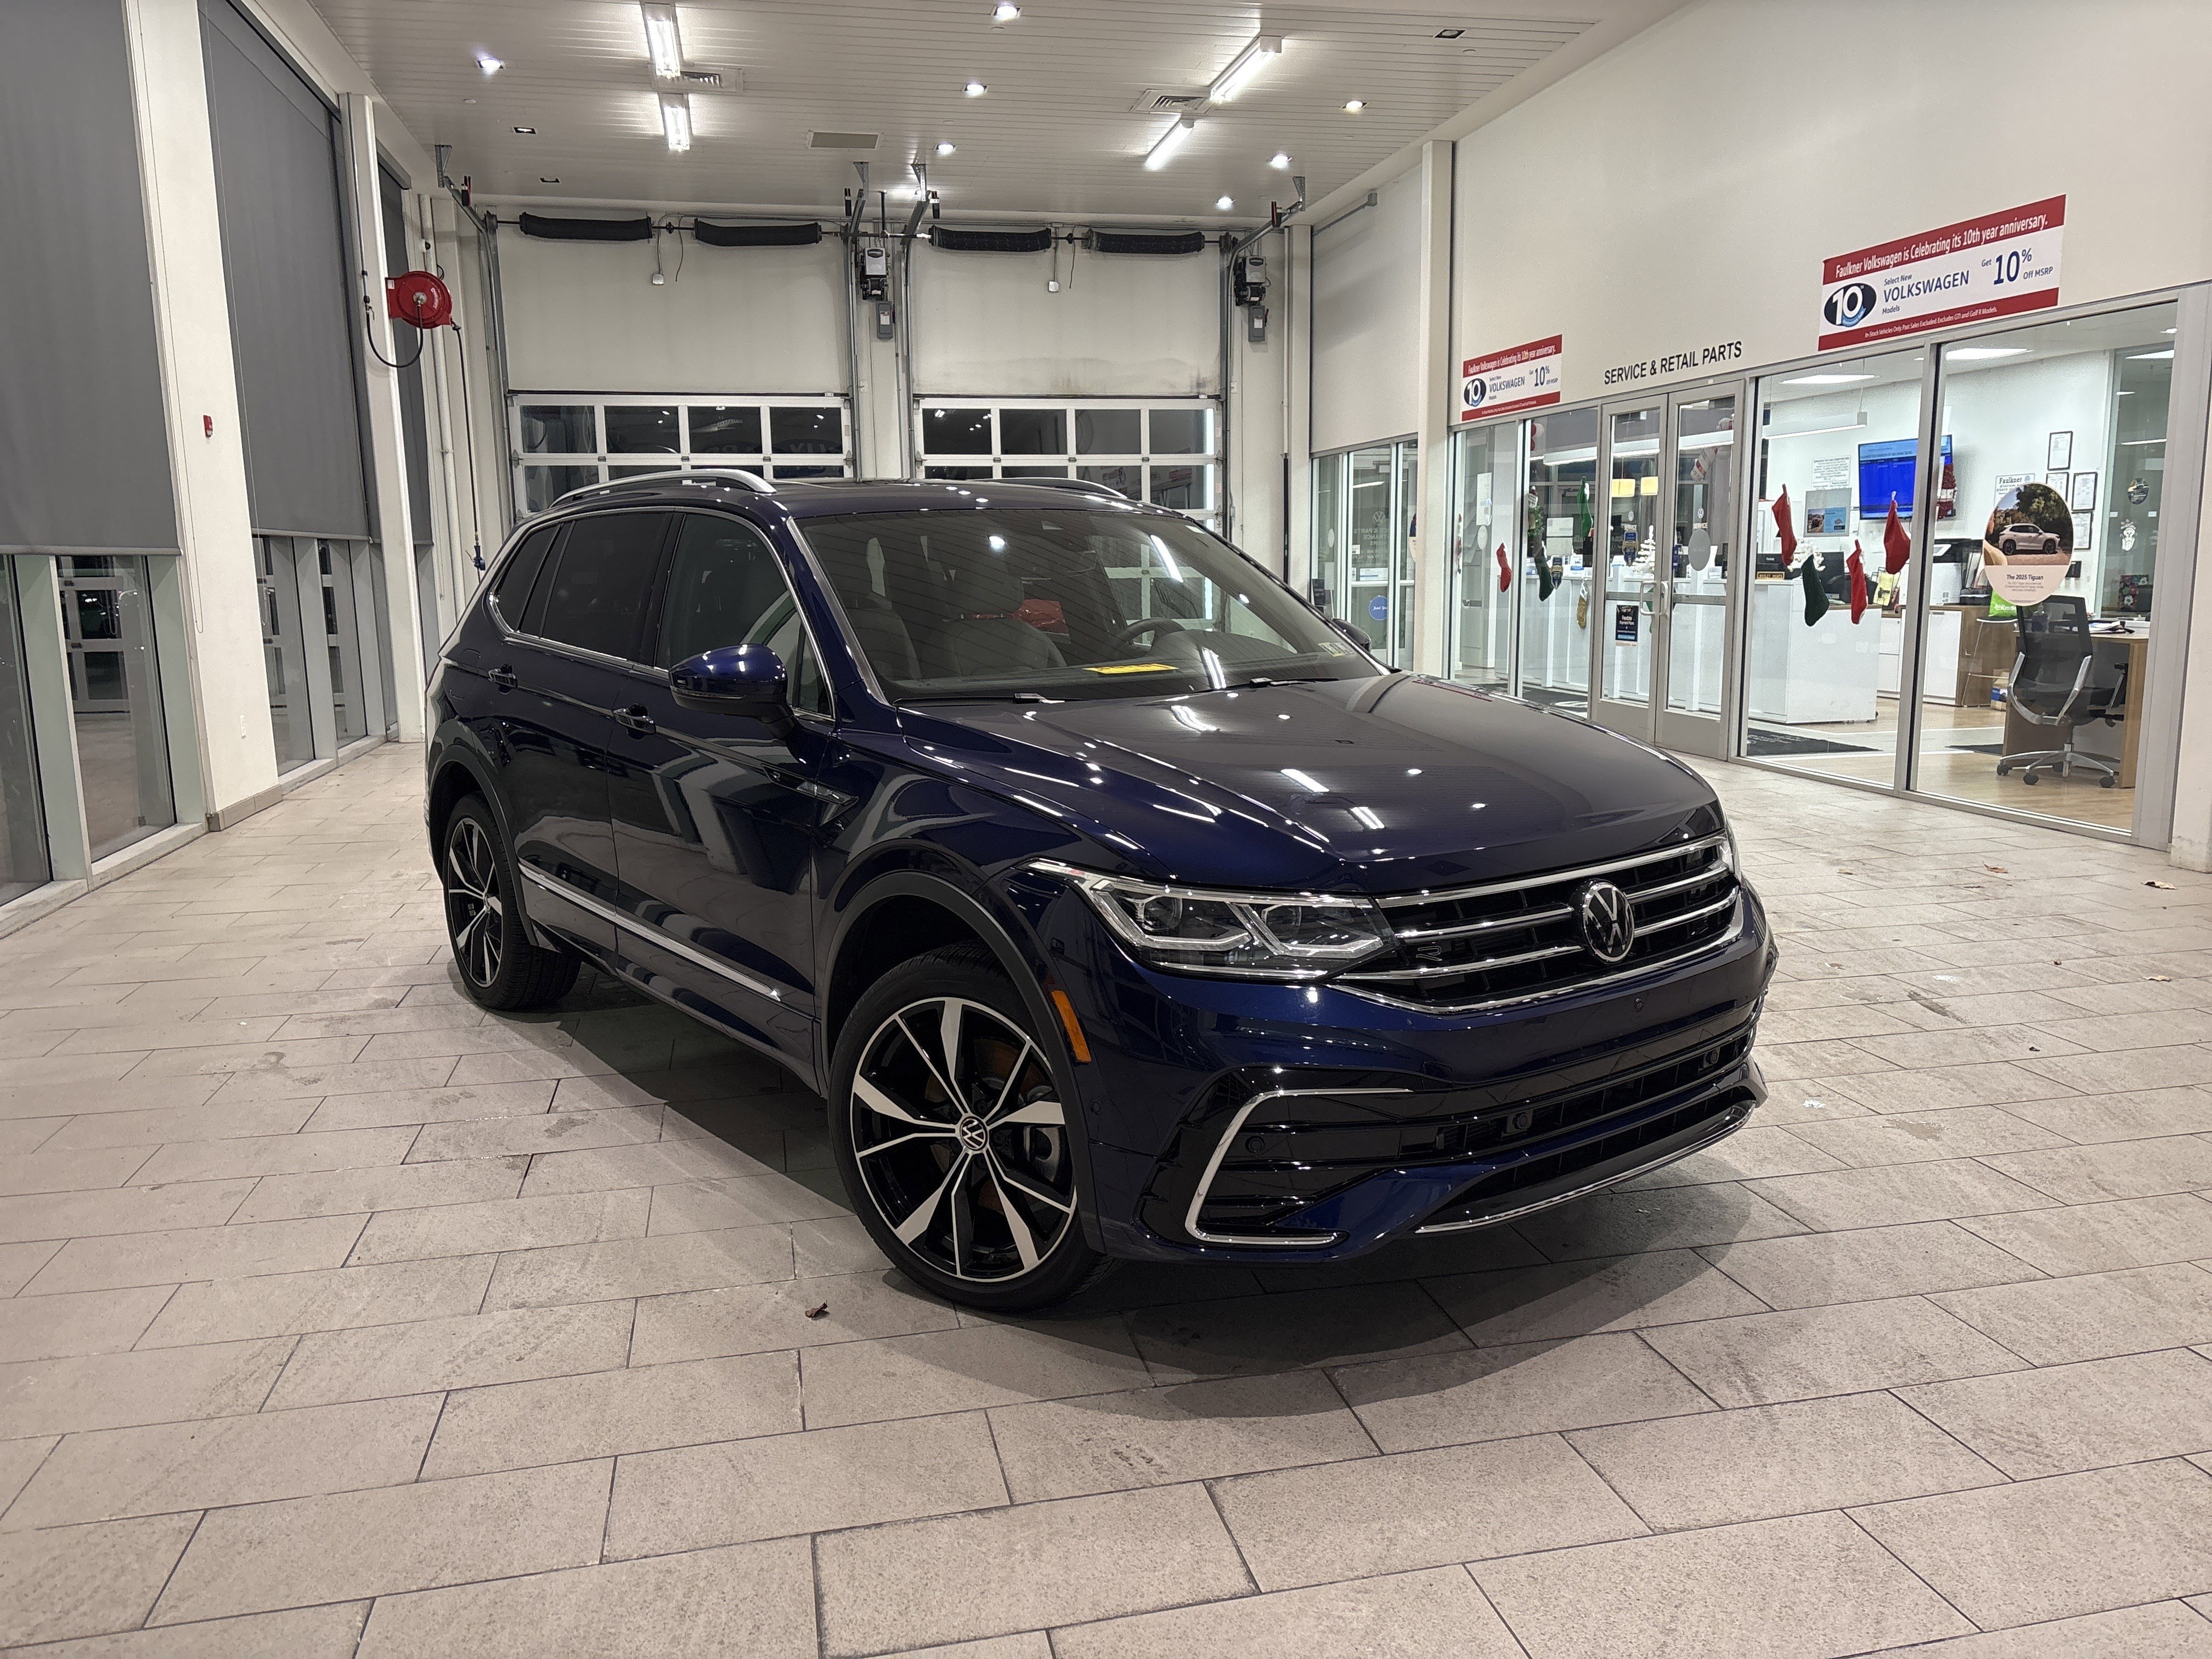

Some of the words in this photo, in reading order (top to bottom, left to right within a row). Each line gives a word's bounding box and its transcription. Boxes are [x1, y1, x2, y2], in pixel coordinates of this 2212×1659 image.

[1836, 261, 1863, 279] Faulkner
[1864, 251, 1902, 272] Volkswagen
[1903, 247, 1909, 261] is
[1911, 237, 1950, 259] Celebrating
[1963, 227, 1980, 246] 10th
[1981, 225, 1999, 245] year
[1999, 213, 2048, 236] anniversary.
[1982, 259, 1992, 267] Get
[1884, 276, 1900, 286] Select
[1901, 274, 1912, 284] New
[2023, 270, 2034, 280] Off
[2035, 266, 2053, 278] MSRP
[1883, 270, 1970, 303] VOLKSWAGEN
[1832, 285, 1863, 325] 10
[1882, 304, 1900, 315] Models
[1604, 360, 1646, 386] SERVICE
[1650, 359, 1657, 375] &
[1660, 350, 1699, 375] RETAIL
[1702, 340, 1742, 366] PARTS
[1489, 376, 1525, 393] VOLKSWAGEN
[1999, 476, 2023, 484] Faulkner
[2028, 574, 2044, 582] Tiguan
